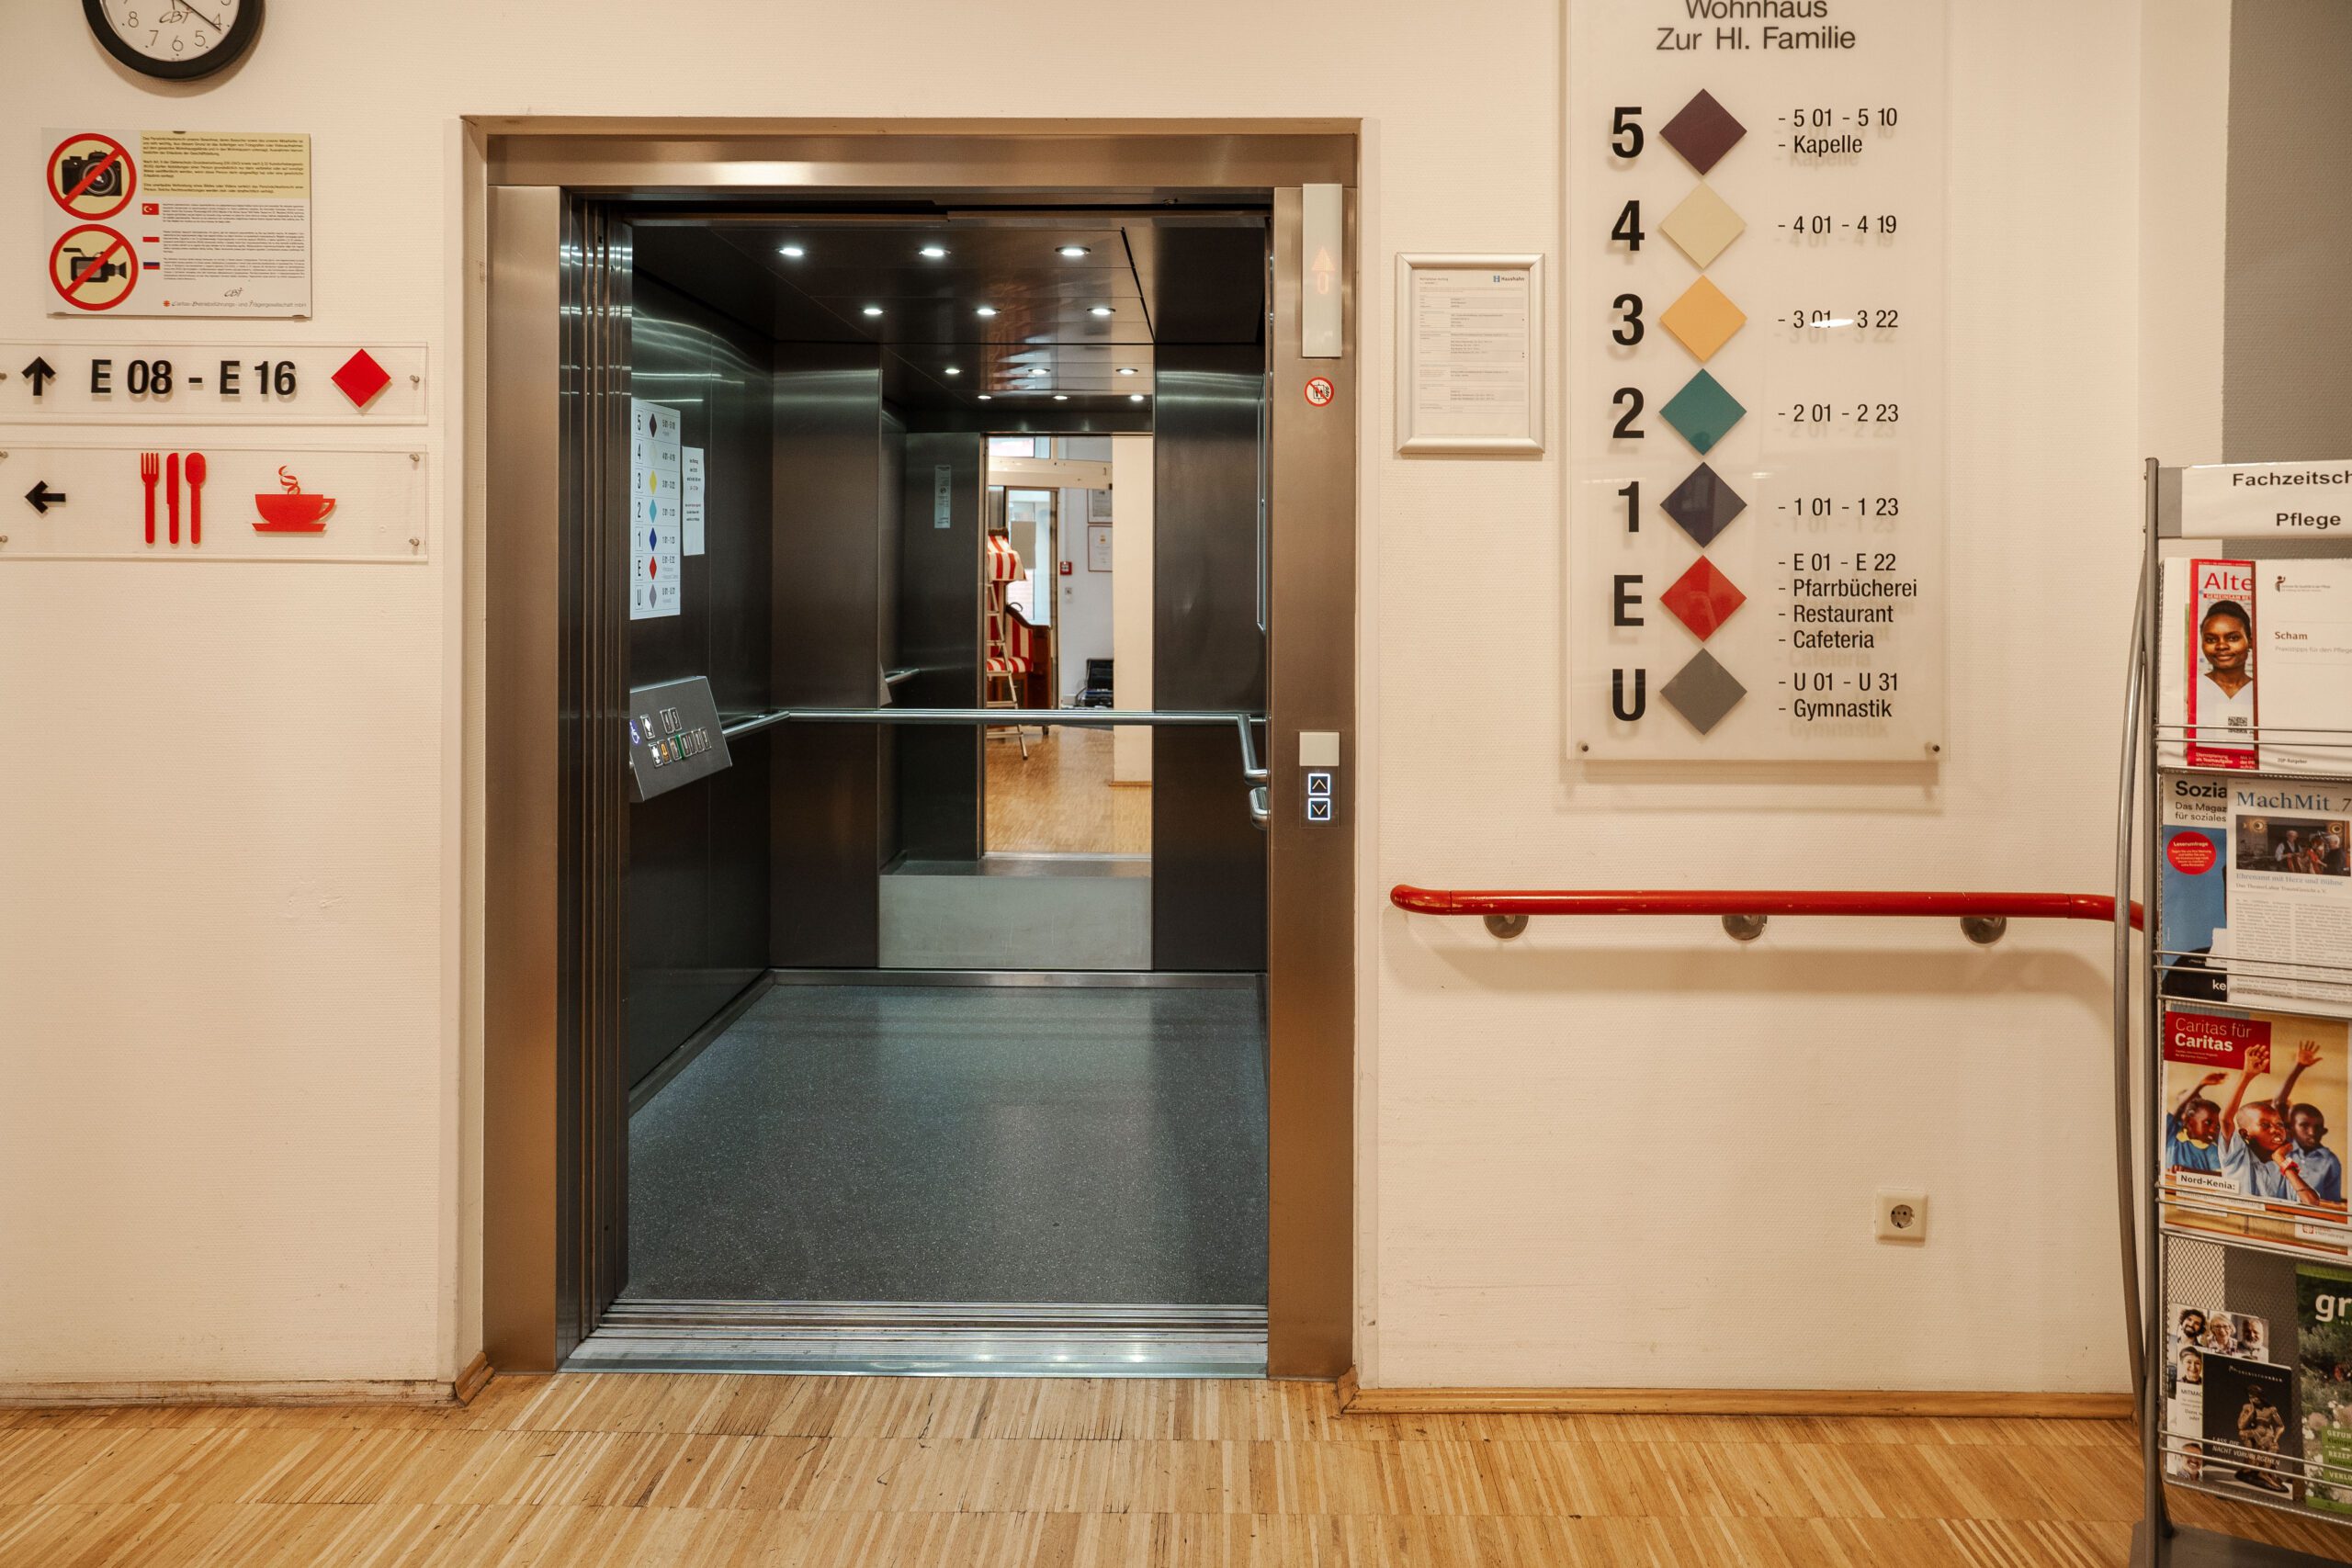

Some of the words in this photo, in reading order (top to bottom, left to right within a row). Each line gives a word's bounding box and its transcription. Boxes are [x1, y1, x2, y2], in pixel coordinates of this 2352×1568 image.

[128, 10, 140, 28] 8
[1685, 0, 1828, 19] Wohnhaus
[211, 13, 222, 27] 4
[148, 29, 159, 47] 7
[171, 35, 184, 52] 6
[194, 29, 206, 48] 5
[1656, 27, 1702, 51] Zur
[1716, 27, 1750, 50] Hl.
[1763, 25, 1856, 50] Familie
[1793, 108, 1805, 128] 5
[1812, 108, 1831, 128] 01
[1858, 107, 1869, 127] 5
[1877, 107, 1897, 127] 10
[1611, 107, 1645, 159] 5
[1794, 134, 1862, 158] Kapelle
[1611, 199, 1645, 252] 4
[1792, 215, 1805, 234] 4
[1812, 215, 1831, 234] 01
[1857, 215, 1869, 233] 4
[1877, 215, 1897, 234] 19
[1611, 293, 1645, 346] 3
[1792, 310, 1804, 329] 3
[1857, 310, 1868, 329] 3
[1875, 310, 1898, 328] 22
[90, 358, 112, 394] E
[127, 359, 173, 395] 08
[220, 360, 241, 395] E
[254, 360, 297, 396] 16
[1612, 387, 1645, 439] 2
[1793, 403, 1804, 423] 2
[1812, 403, 1831, 423] 01
[1857, 403, 1869, 423] 2
[1876, 403, 1899, 423] 23
[1618, 480, 1640, 533] 1
[1794, 497, 1802, 516] 1
[1812, 497, 1831, 516] 01
[1858, 497, 1865, 516] 1
[1875, 497, 1899, 516] 23
[2276, 513, 2341, 530] Pflege
[1793, 553, 1804, 571] E
[1811, 553, 1830, 571] 01
[1856, 553, 1867, 571] E
[1873, 553, 1896, 571] 22
[1793, 578, 1917, 597] Pfarrbücherei
[2204, 571, 2251, 591] Alte
[1613, 574, 1645, 626] E
[1793, 604, 1894, 623] Restaurant
[1793, 629, 1875, 649] Cafeteria
[2274, 631, 2308, 640] Scham
[1793, 672, 1806, 692] U
[1814, 672, 1833, 692] 01
[1859, 672, 1871, 692] U
[1878, 672, 1897, 692] 31
[1611, 668, 1646, 722] U
[1793, 698, 1893, 722] Gymnastik
[2175, 780, 2227, 798] Sozia
[2175, 801, 2193, 810] Das
[2195, 803, 2227, 814] Magaz
[2236, 791, 2330, 811] MachMit
[2175, 811, 2188, 820] für
[2190, 814, 2227, 822] soziales
[2212, 979, 2227, 990] ke
[2176, 1017, 2227, 1036] Caritas
[2232, 1022, 2252, 1038] für
[2175, 1032, 2233, 1052] Caritas
[2180, 1175, 2235, 1190] Nord-Kenia:
[2315, 1294, 2352, 1322] gr
[2211, 1445, 2232, 1454] NACHT
